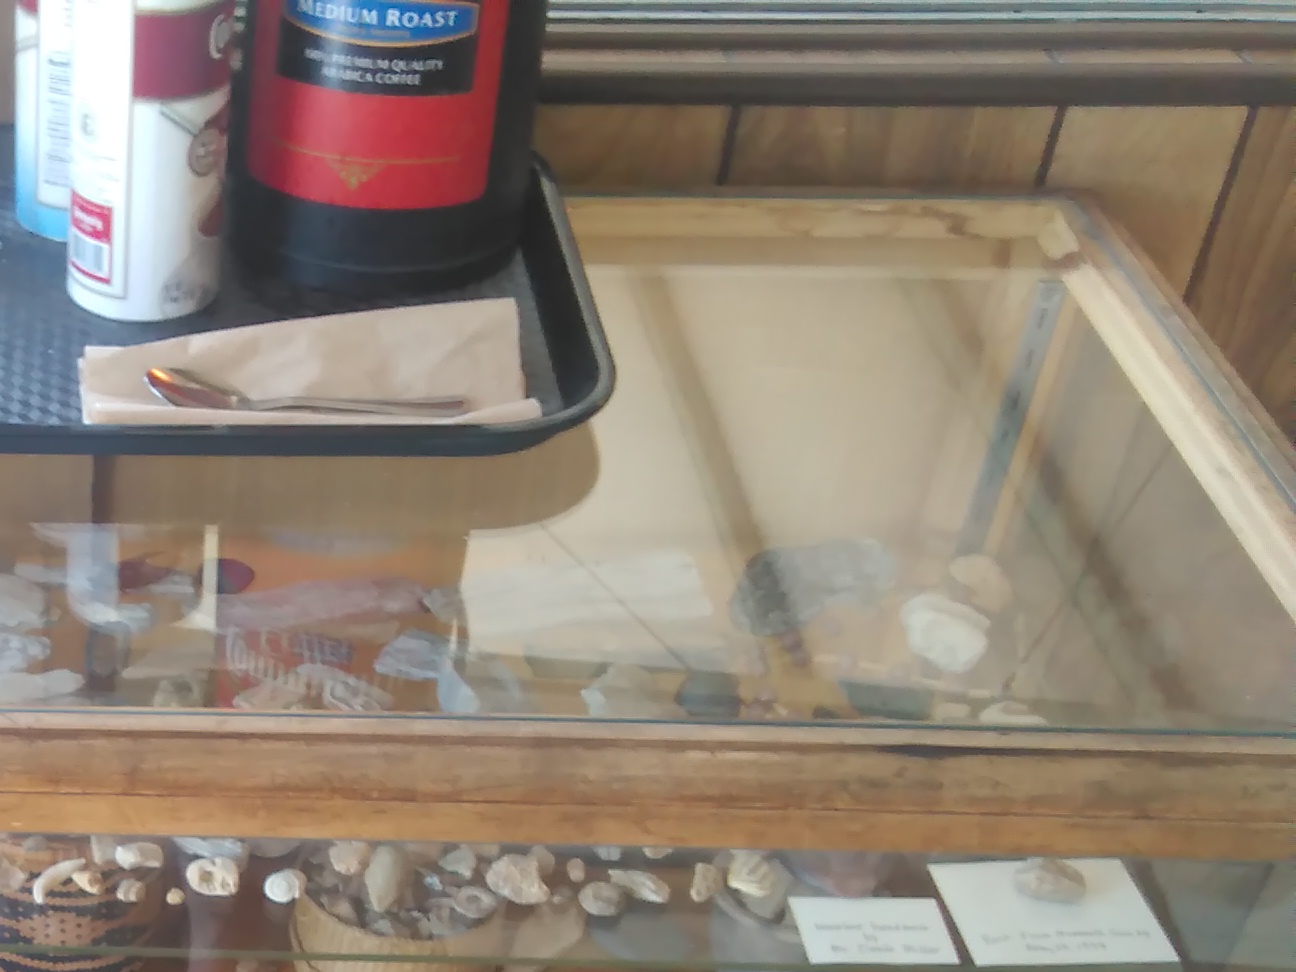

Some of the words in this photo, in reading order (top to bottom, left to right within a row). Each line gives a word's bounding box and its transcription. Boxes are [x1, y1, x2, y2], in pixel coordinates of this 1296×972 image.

[297, 0, 378, 25] MEDIUM
[385, 7, 458, 28] ROAST
[330, 53, 389, 70] PREMIUM
[391, 58, 444, 72] QUALITY
[321, 66, 373, 83] ARABICA
[375, 72, 421, 86] COFFEE
